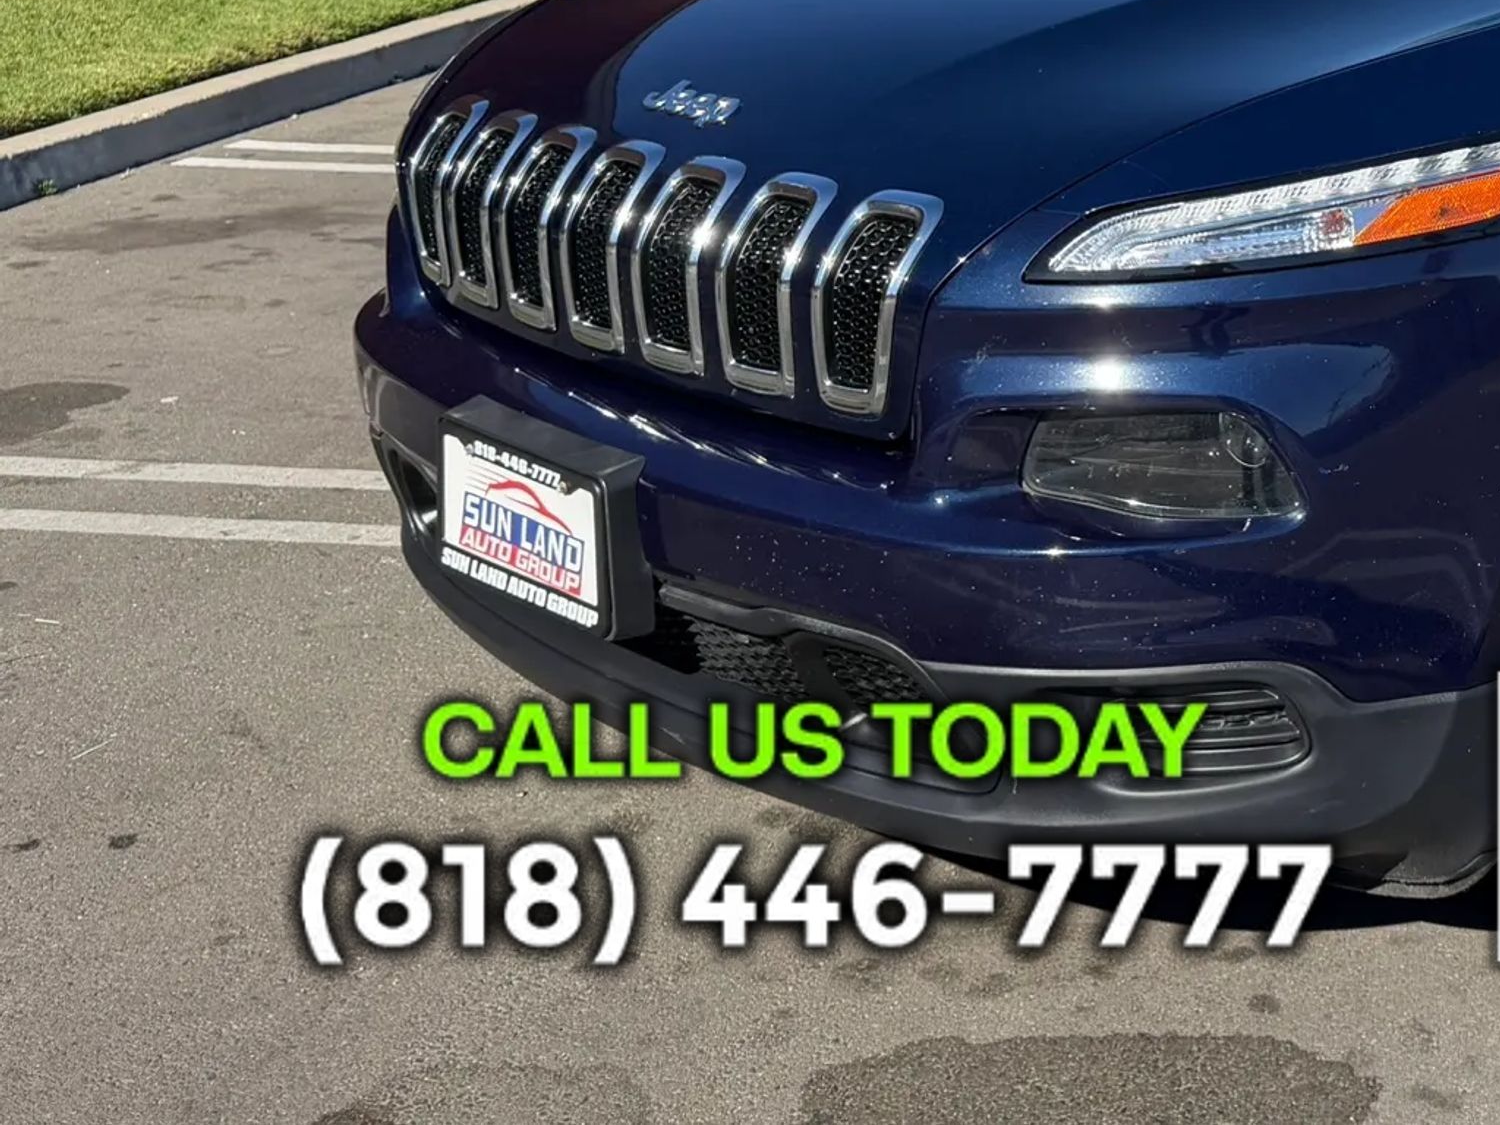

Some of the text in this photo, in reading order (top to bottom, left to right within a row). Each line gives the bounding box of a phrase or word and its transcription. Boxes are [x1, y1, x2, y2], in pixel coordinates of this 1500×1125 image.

[643, 79, 740, 128] Jeep
[462, 527, 580, 594] AUTO GROUP
[464, 493, 584, 573] SUN LAND
[441, 546, 599, 629] SUN LAND AUTO GROUP
